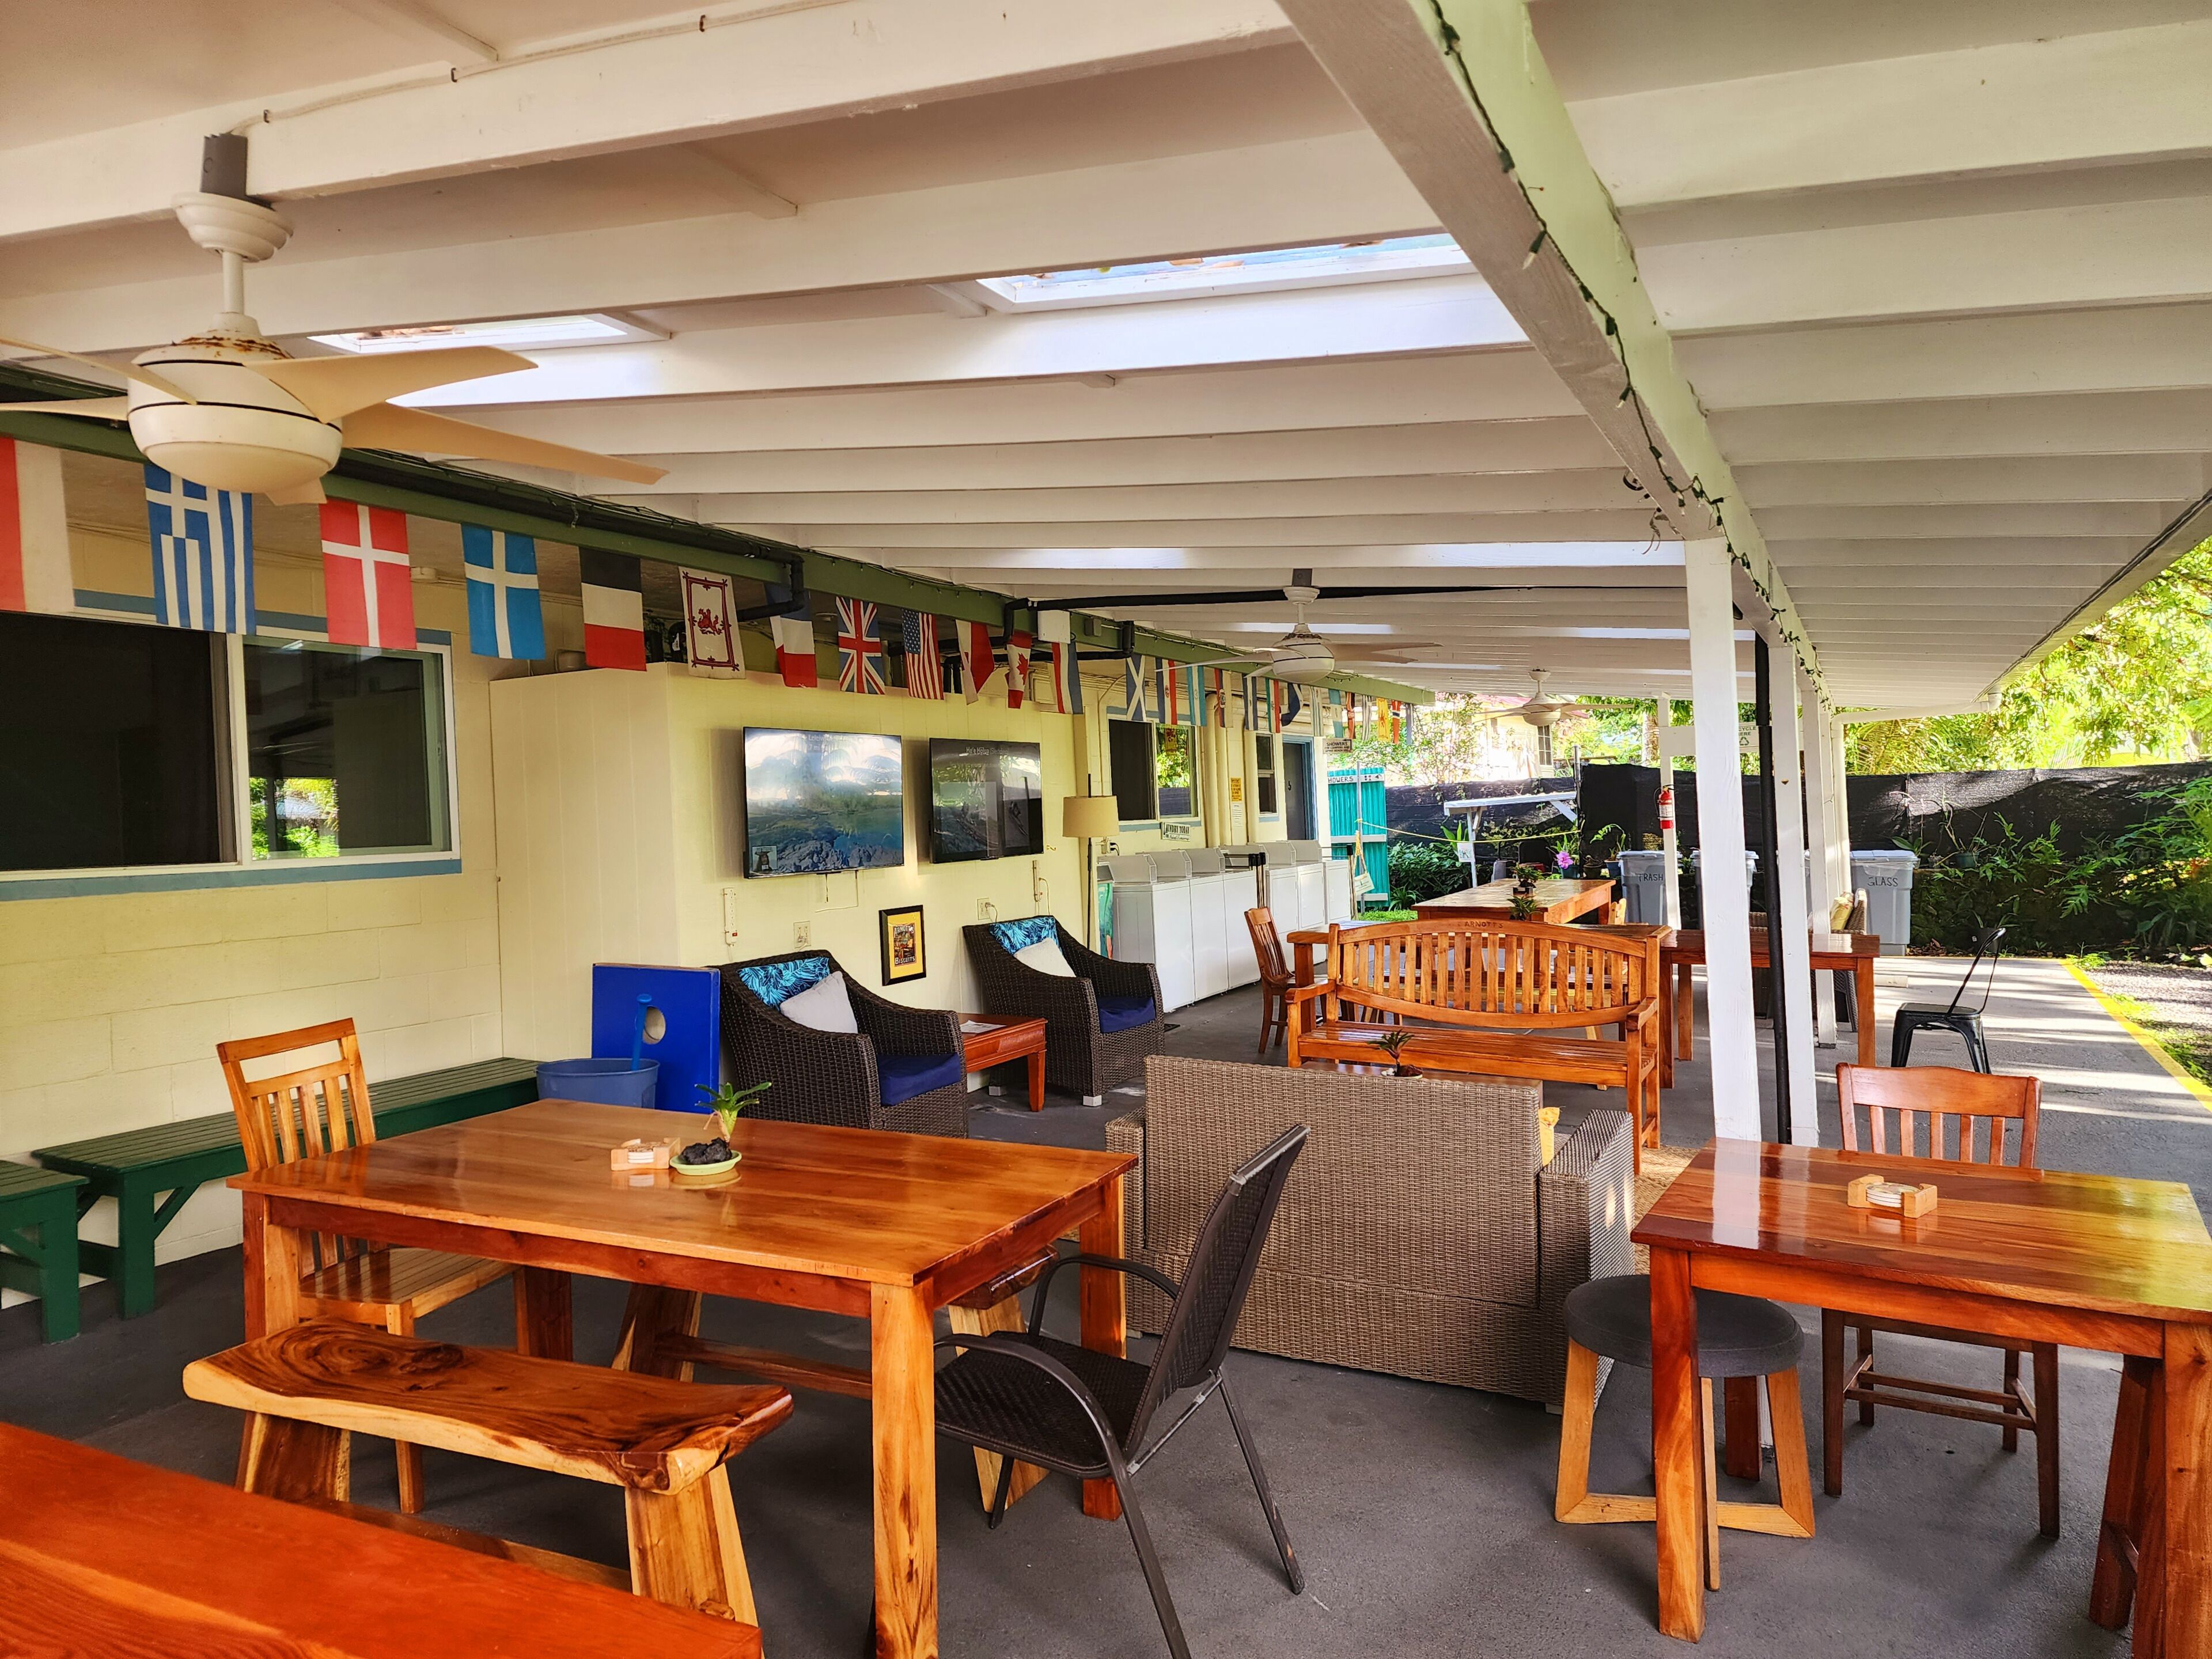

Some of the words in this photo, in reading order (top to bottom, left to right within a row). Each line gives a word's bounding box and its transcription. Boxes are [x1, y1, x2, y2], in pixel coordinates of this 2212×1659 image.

[1164, 823, 1178, 835] LAUNDRY
[1636, 873, 1663, 882] TRASH
[1868, 877, 1898, 887] GLASS
[894, 925, 915, 938] ARNOTTS
